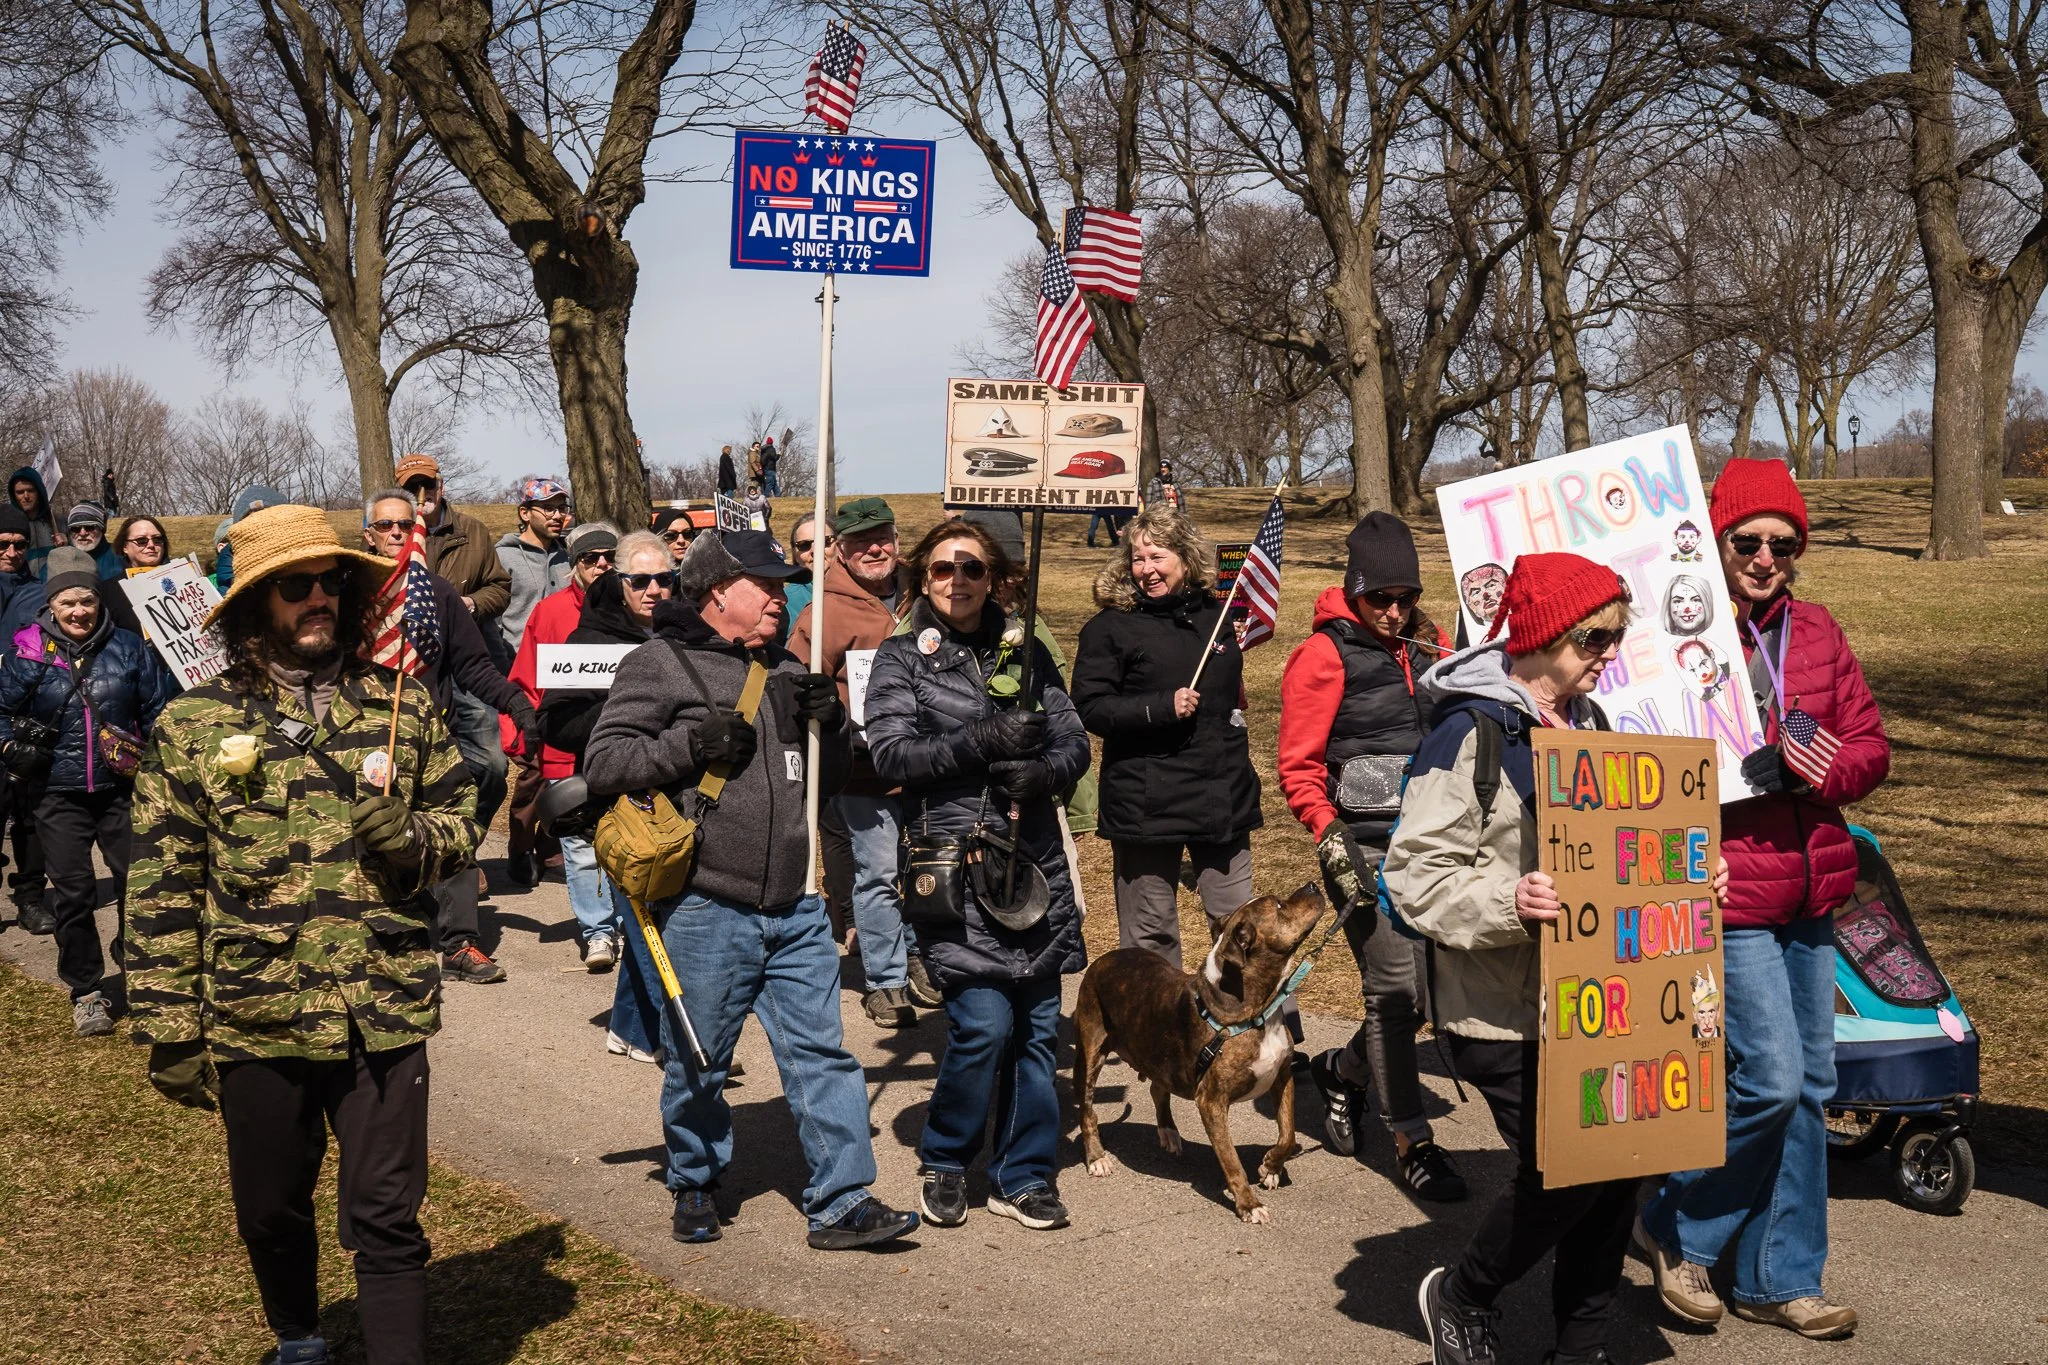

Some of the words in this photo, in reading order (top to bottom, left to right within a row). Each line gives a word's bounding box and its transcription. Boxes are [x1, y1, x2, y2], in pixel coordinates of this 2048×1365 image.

[750, 165, 798, 193] NO
[812, 168, 918, 198] KINGS
[826, 197, 841, 213] IN
[749, 212, 915, 244] AMERICA
[792, 242, 834, 258] SINCE
[838, 244, 872, 259] 1776
[953, 382, 1048, 401] SAME
[1058, 386, 1139, 403] SHIT
[720, 496, 749, 519] HANDS
[951, 486, 1080, 504] DIFFERENT
[1086, 489, 1135, 505] HAT
[1460, 438, 1690, 564] THROW
[1221, 551, 1247, 560] WHEN
[175, 583, 205, 605] WARS
[188, 597, 209, 613] ICE
[145, 595, 191, 641] NO
[166, 633, 204, 666] TAX
[184, 654, 229, 687] PROTE
[551, 662, 572, 674] NO
[579, 662, 620, 674] KING
[1547, 749, 1664, 811] LAND
[1681, 759, 1710, 800] of
[1549, 824, 1595, 873] the
[1553, 902, 1599, 943] no
[1614, 897, 1717, 963] HOME
[1556, 975, 1632, 1040] FOR
[1661, 979, 1686, 1024] a
